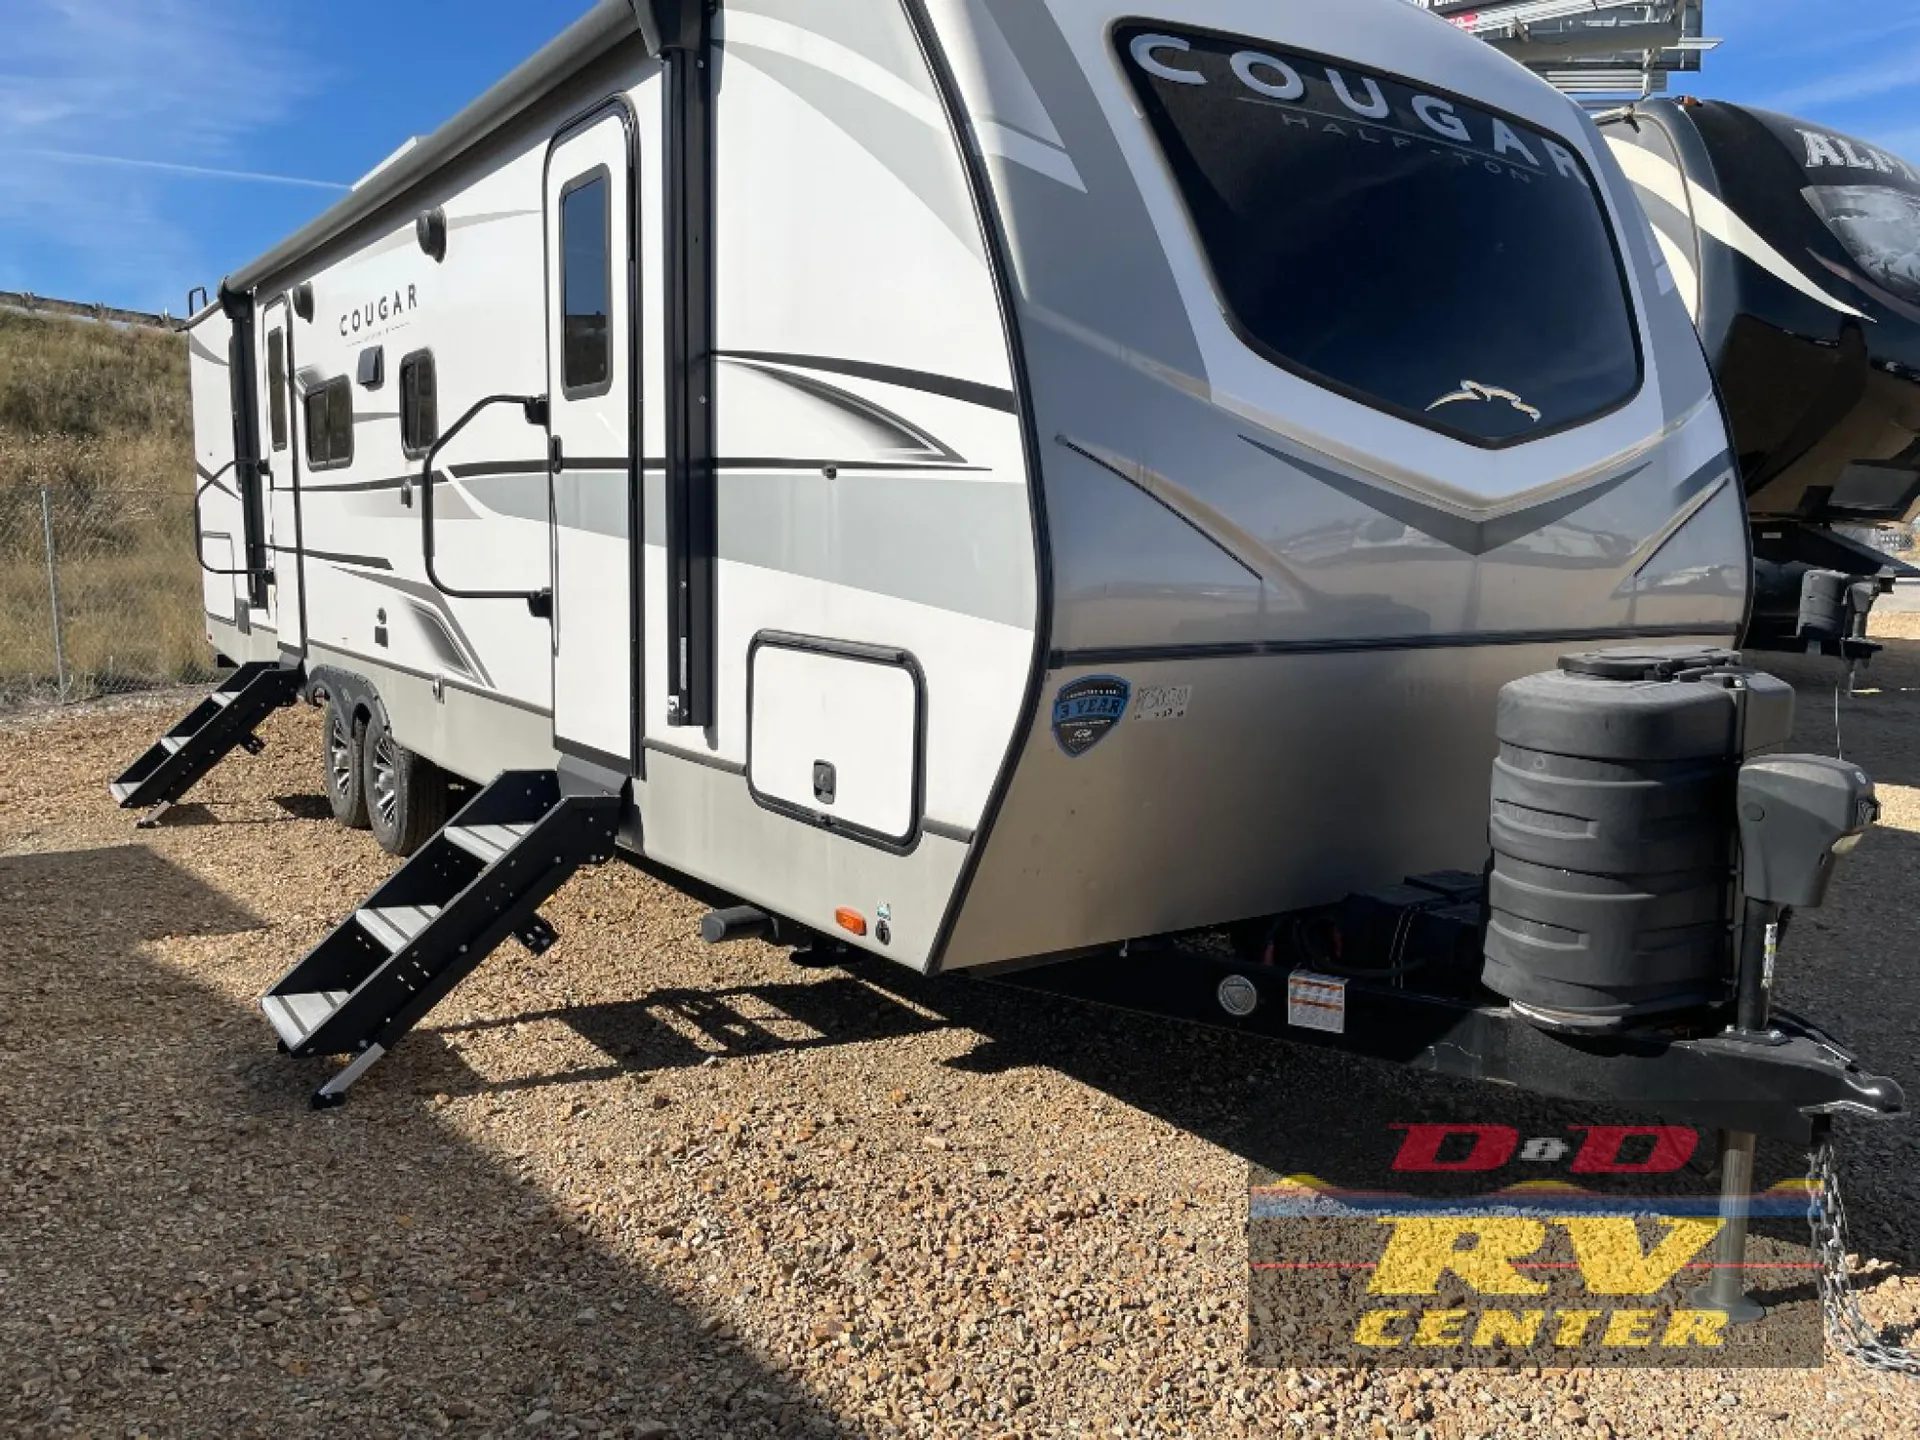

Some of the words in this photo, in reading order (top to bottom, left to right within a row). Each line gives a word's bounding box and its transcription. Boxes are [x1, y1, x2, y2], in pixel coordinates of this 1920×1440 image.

[1129, 33, 1587, 188] COUGAR
[340, 283, 417, 336] COUGAR
[1076, 698, 1121, 714] YEAR
